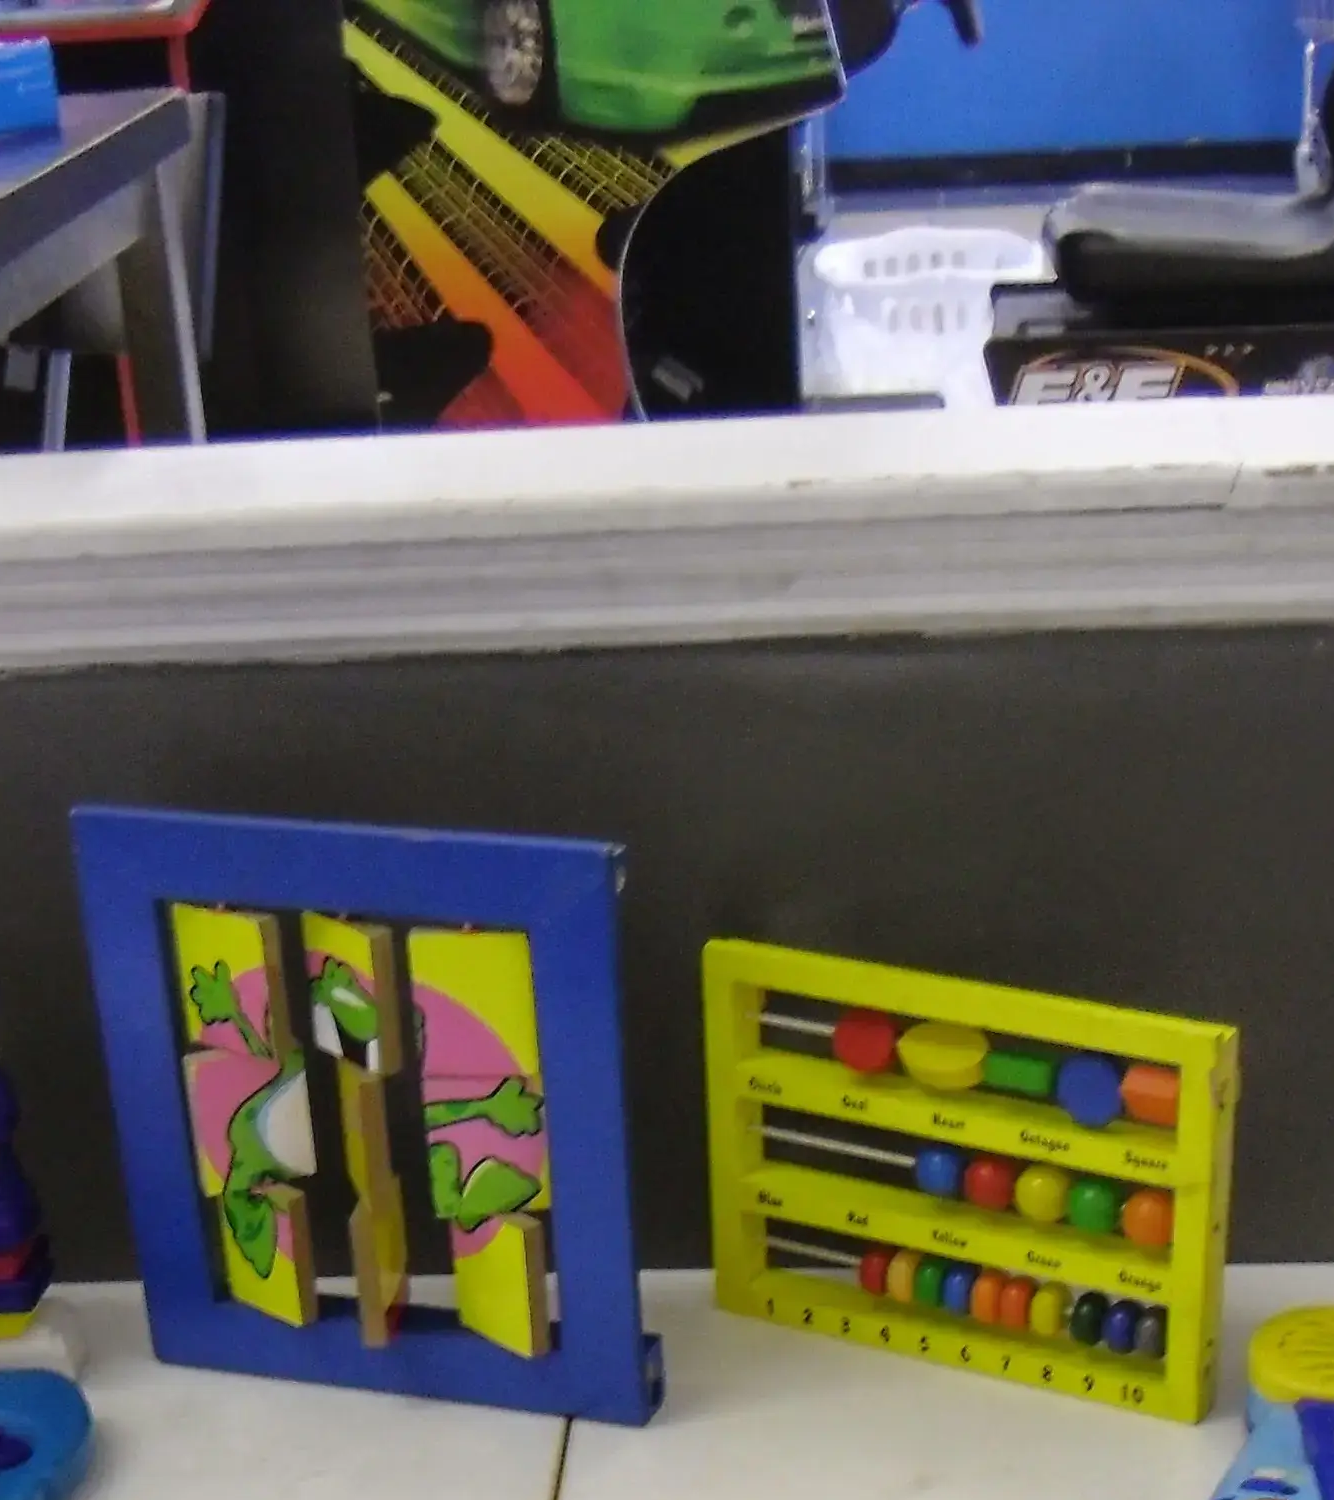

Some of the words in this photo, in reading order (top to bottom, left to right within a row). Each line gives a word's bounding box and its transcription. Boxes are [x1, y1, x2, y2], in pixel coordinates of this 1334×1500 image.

[803, 1308, 814, 1325] 2
[841, 1316, 851, 1333] 3
[880, 1325, 890, 1343] 4
[919, 1335, 929, 1353] 5
[960, 1344, 971, 1363] 6
[1001, 1355, 1011, 1373] 7
[1041, 1364, 1053, 1383] 8
[1083, 1373, 1095, 1392] 9
[1121, 1383, 1144, 1404] 10
